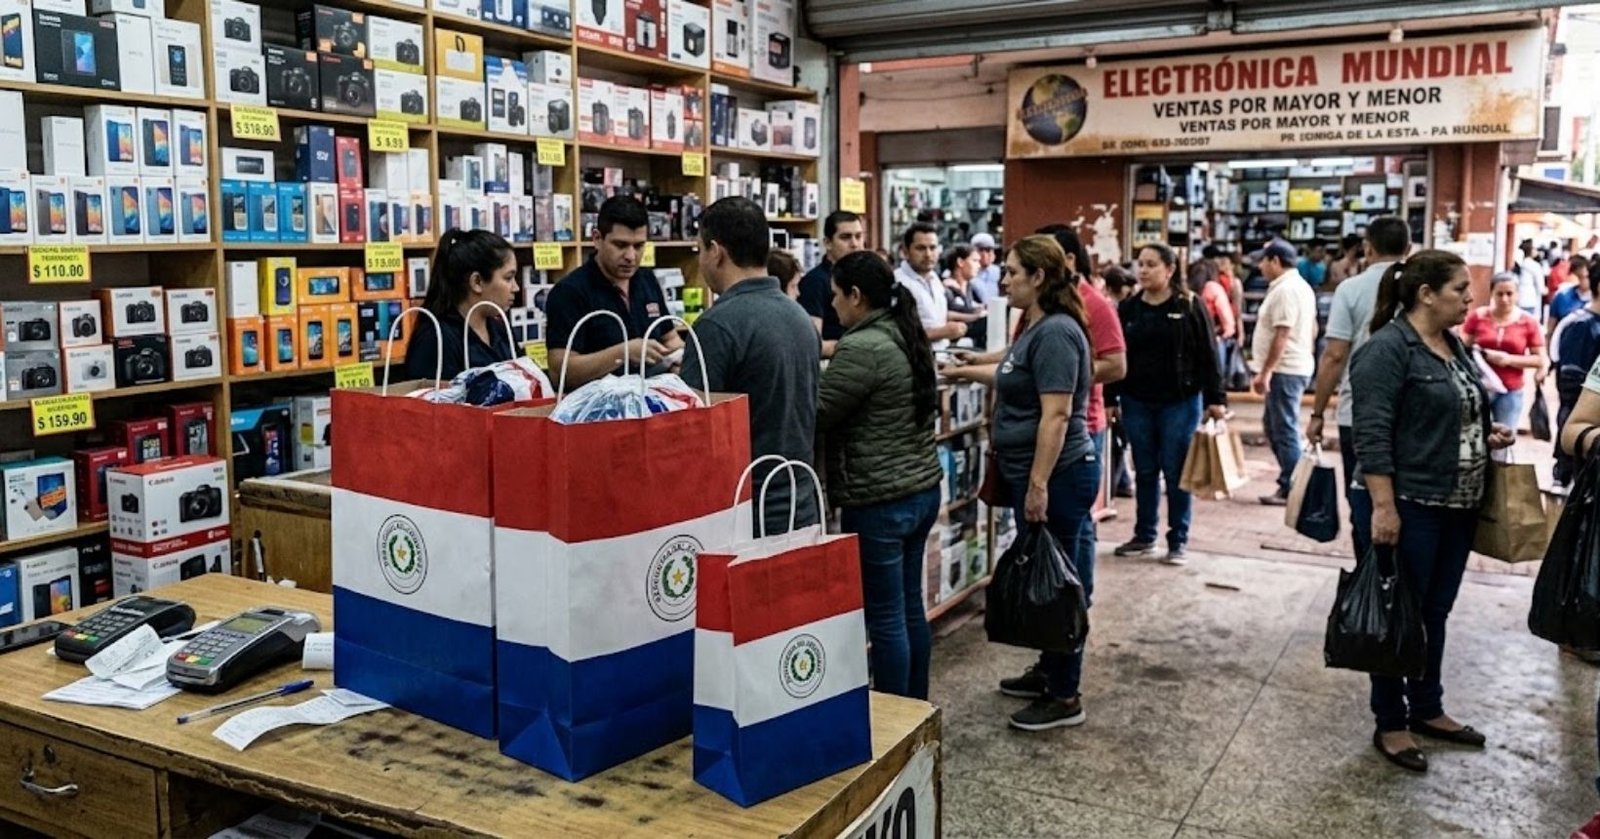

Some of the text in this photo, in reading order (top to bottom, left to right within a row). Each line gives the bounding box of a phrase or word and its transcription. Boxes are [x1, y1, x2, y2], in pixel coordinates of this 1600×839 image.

[1104, 41, 1512, 98] ELECTRÓNICA MUNDIAL
[1153, 87, 1442, 118] VENTAS POR MAYOR Y MENOR
[236, 121, 242, 134] $
[1179, 110, 1410, 133] VENTAS POR MAYOR Y MENOR
[1347, 130, 1363, 140] DE
[1367, 129, 1383, 139] LA
[1387, 128, 1420, 139] ESTA
[1431, 126, 1448, 137] PA
[33, 264, 41, 278] $
[38, 411, 88, 430] $ 159.90
